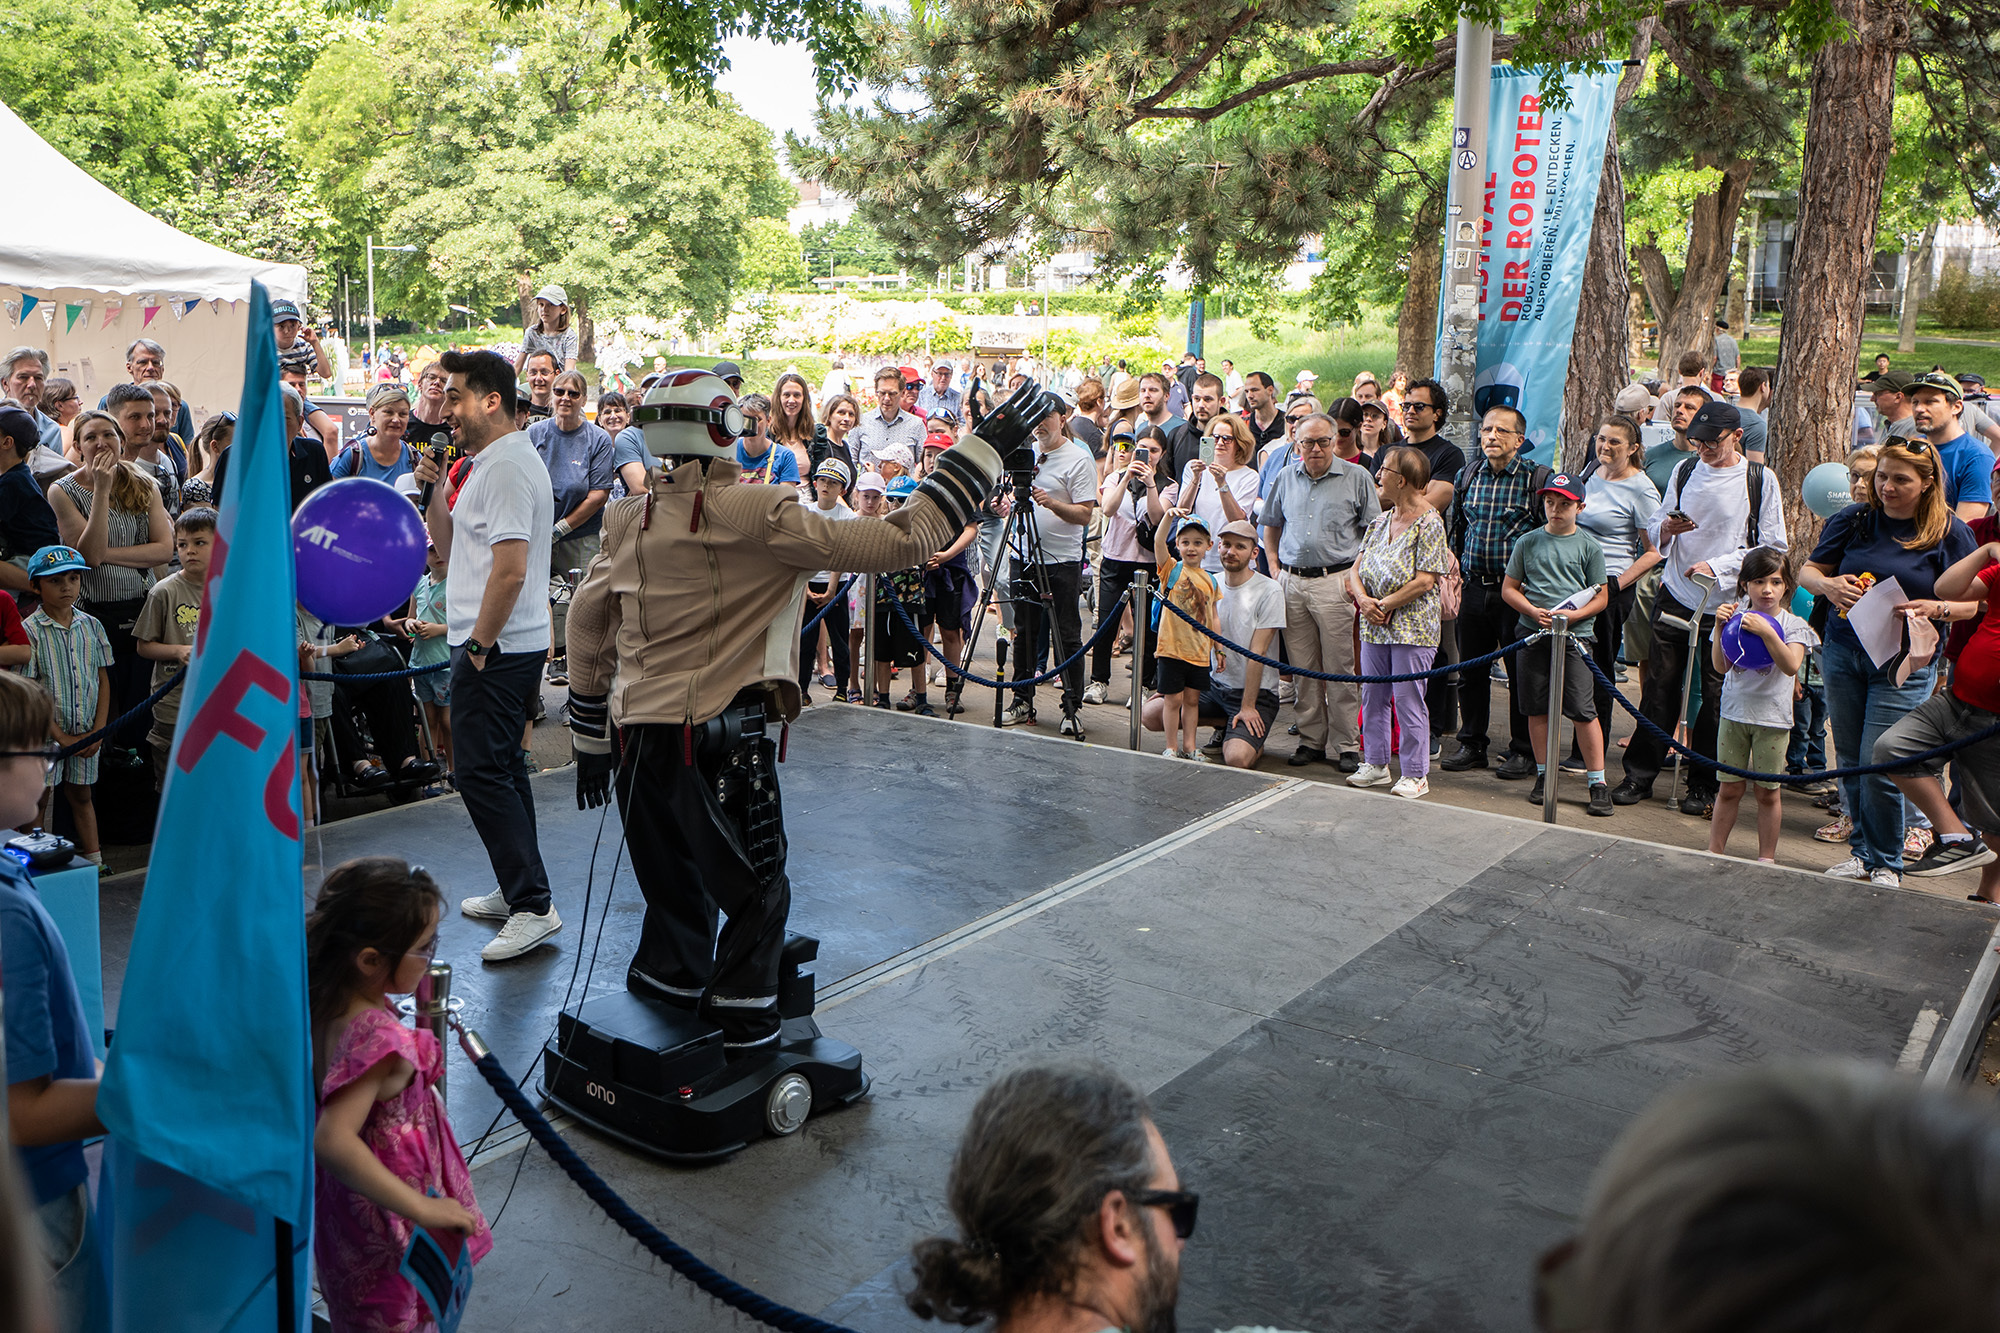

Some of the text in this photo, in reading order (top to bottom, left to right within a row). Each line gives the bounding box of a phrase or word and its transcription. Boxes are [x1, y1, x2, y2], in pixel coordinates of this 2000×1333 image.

[1500, 94, 1543, 322] DER ROBOTER
[1521, 266, 1538, 321] ROBO
[1546, 117, 1562, 195] ENTDECKEN.
[1534, 224, 1559, 321] AUSPROBIEREN.
[47, 550, 74, 563] SURF
[299, 525, 339, 550] AIT
